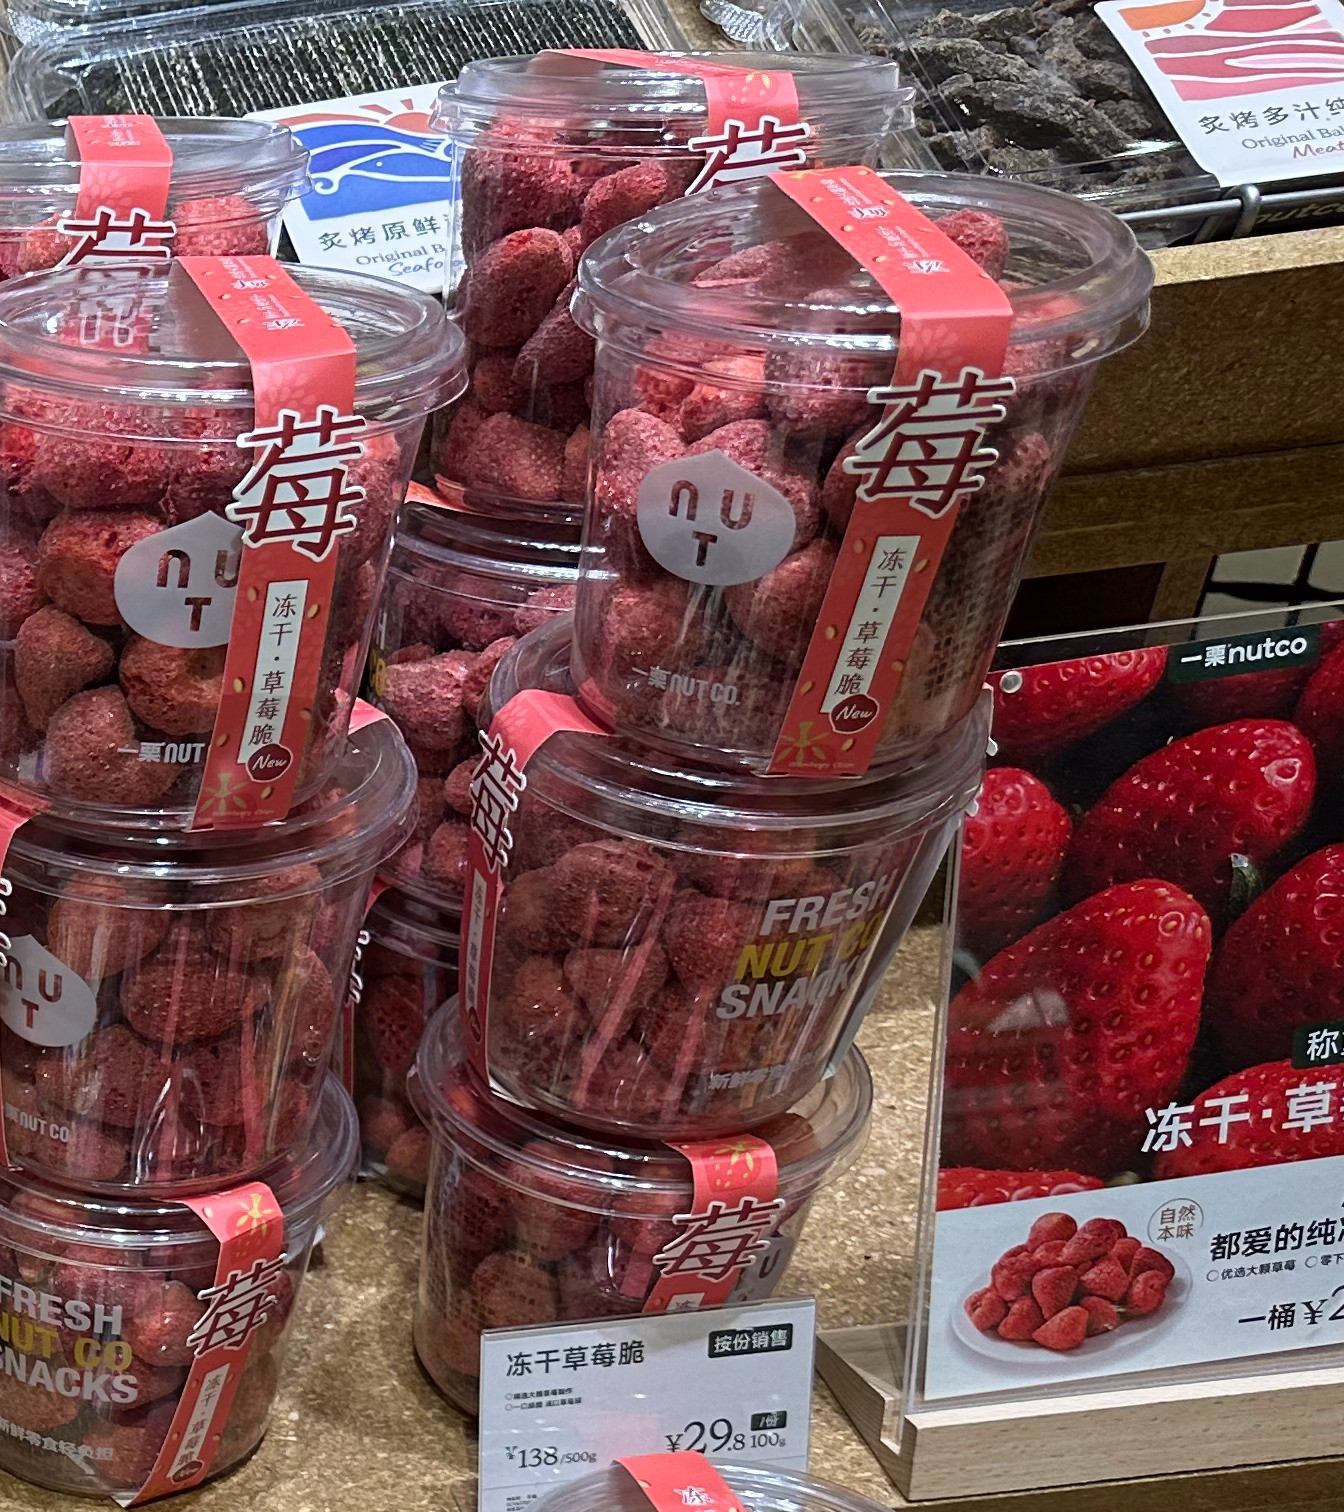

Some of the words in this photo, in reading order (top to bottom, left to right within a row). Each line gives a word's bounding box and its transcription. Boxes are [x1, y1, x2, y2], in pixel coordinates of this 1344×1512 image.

[1242, 130, 1315, 149] Original
[318, 214, 453, 251] 炙烤原鲜
[355, 244, 428, 267] Original
[849, 371, 1014, 515] 莓
[236, 409, 367, 556] 莓
[834, 703, 875, 722] New
[251, 754, 287, 770] New
[735, 932, 831, 981] NUT
[1141, 1083, 1344, 1153] 冻干·草
[1157, 1222, 1194, 1242] 本味
[1158, 1206, 1196, 1225] 自然
[655, 1199, 784, 1279] 莓
[1210, 1216, 1344, 1262] 都爱的纯
[1238, 1302, 1296, 1331] 一桶
[73, 1336, 133, 1372] CO
[505, 1340, 646, 1378] 冻干草莓脆
[713, 1329, 789, 1354] 按份销售
